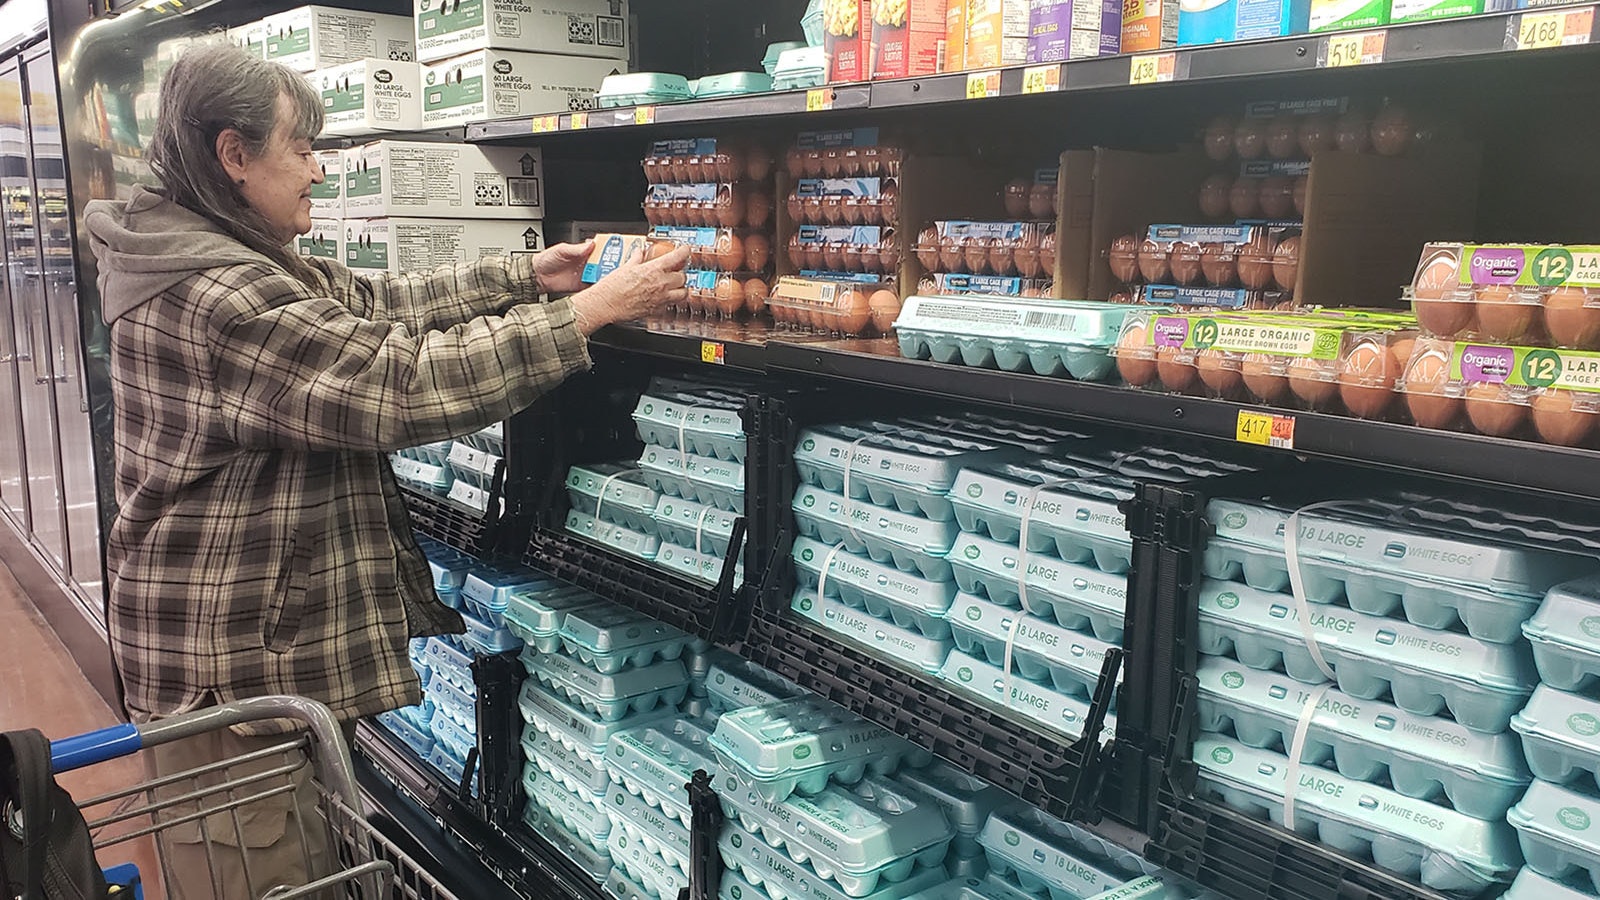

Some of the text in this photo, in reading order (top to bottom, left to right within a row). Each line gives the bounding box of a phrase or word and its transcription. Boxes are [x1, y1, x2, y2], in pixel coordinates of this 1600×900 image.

[502, 75, 523, 83] LARGE
[1190, 227, 1208, 235] LARGE
[1209, 227, 1224, 235] CAGE
[1224, 227, 1240, 235] FREE
[1473, 256, 1517, 270] Organic
[1538, 256, 1567, 278] 12
[1204, 289, 1219, 297] CAGE
[1220, 290, 1236, 298] FREE
[1156, 323, 1184, 335] Organic
[1196, 325, 1215, 343] 12
[1221, 327, 1255, 338] LARGE
[1260, 330, 1310, 342] ORGANIC
[1235, 339, 1251, 347] FREE
[1254, 341, 1277, 349] BROWN
[1464, 353, 1598, 379] Organic 12 LAR
[1565, 374, 1590, 384] CAGE
[850, 451, 872, 465] ARGE
[1300, 527, 1474, 566] 18 LARGE WHITE EGGS
[838, 561, 846, 571] 18
[846, 564, 870, 579] LARGE
[1027, 563, 1059, 581] LARGE
[1087, 583, 1106, 593] WHITE
[837, 613, 845, 623] 18
[845, 616, 868, 633] LARGE
[1015, 623, 1026, 635] 18
[1028, 627, 1059, 647] LARGE
[1310, 614, 1462, 657] LARGE WHITE EGGS
[1018, 689, 1050, 711] LARGE
[1314, 699, 1360, 720] LARGE
[1402, 721, 1433, 738] WHITE
[1435, 729, 1467, 747] EGGS
[850, 734, 860, 744] 18
[648, 762, 666, 781] LARGE
[1300, 774, 1445, 831] LARGE WHITE EGGS
[648, 814, 666, 832] LARGE
[769, 804, 791, 822] LARGE
[809, 829, 824, 844] WHITE
[823, 836, 838, 851] EGGS
[648, 857, 665, 877] LARGE
[765, 854, 773, 867] 18
[772, 859, 795, 882] LARGE
[1055, 855, 1098, 884] 18 LARGE
